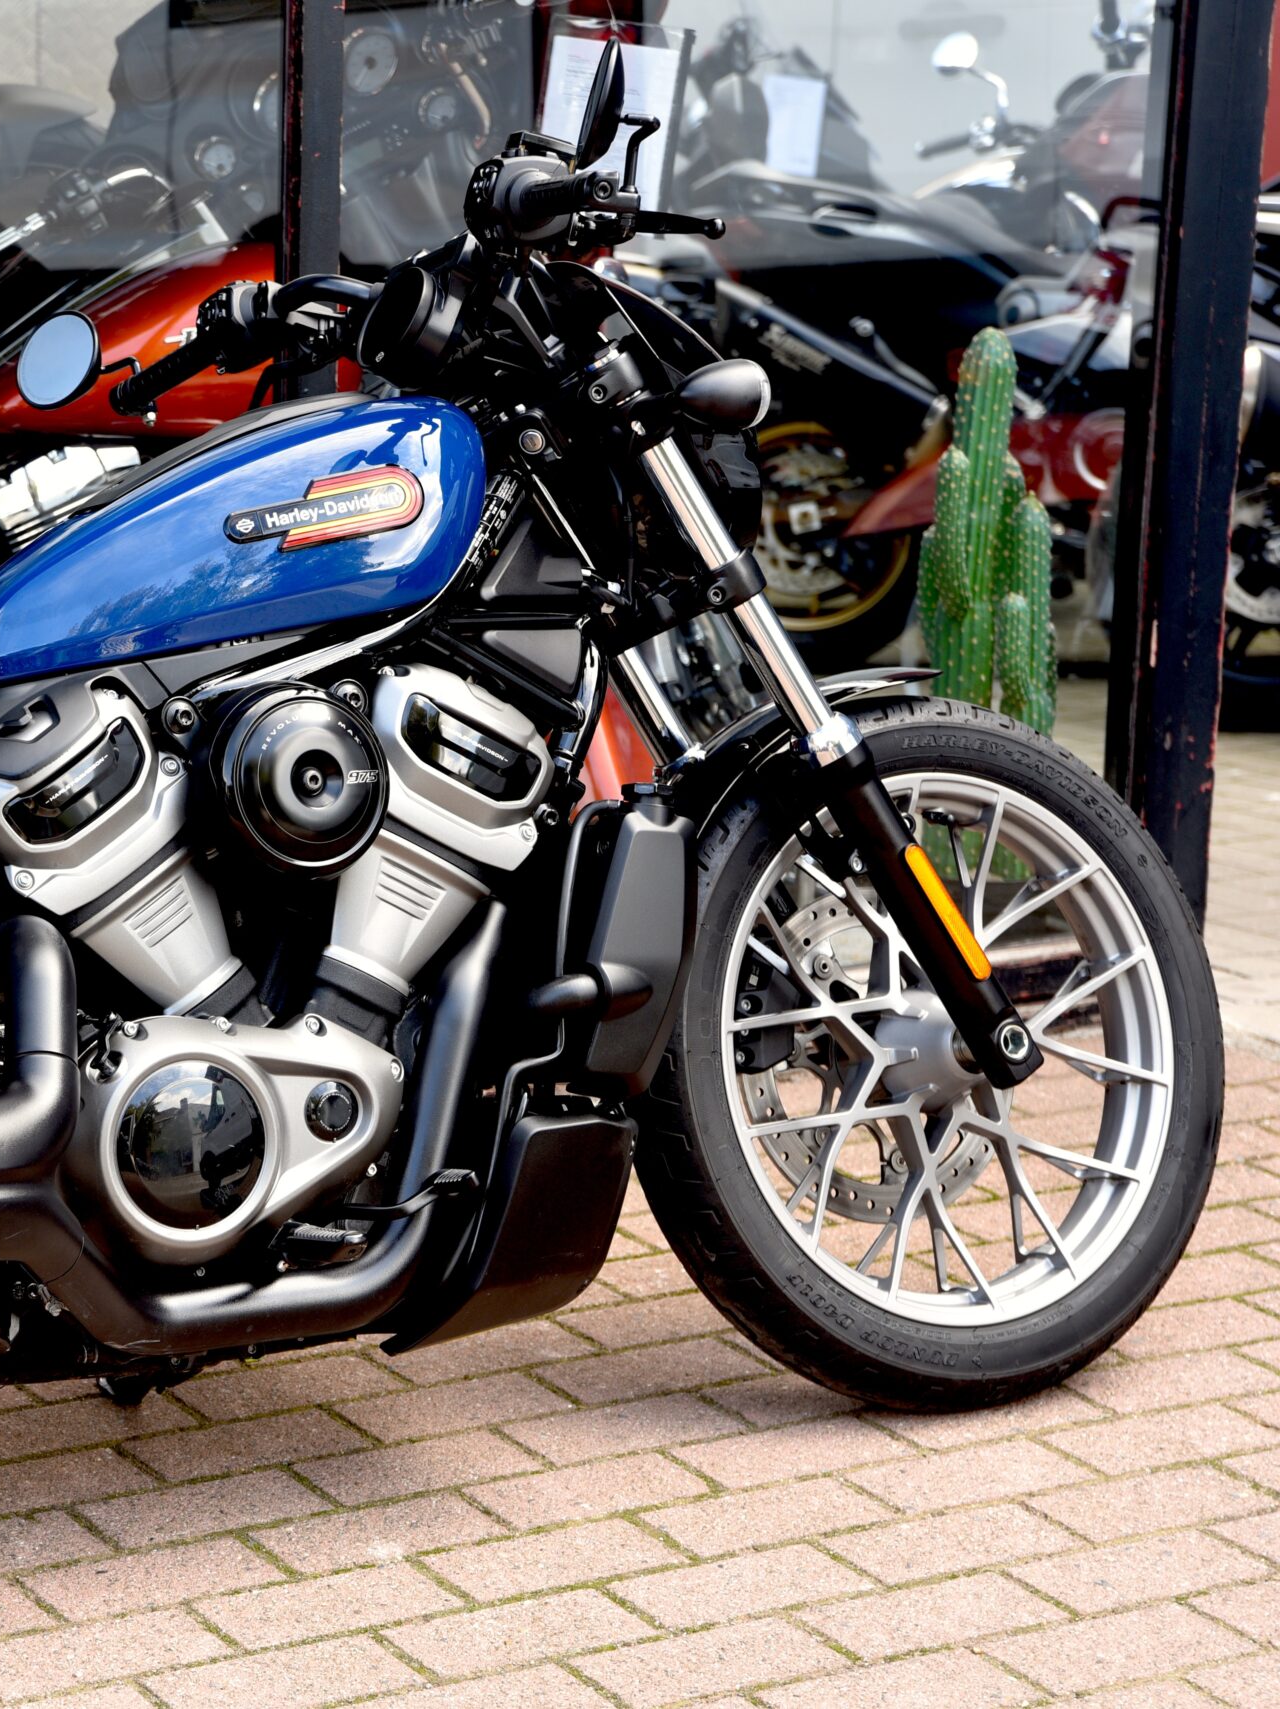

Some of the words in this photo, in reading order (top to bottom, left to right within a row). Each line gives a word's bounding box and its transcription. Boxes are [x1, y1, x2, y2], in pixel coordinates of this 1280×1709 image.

[337, 721, 362, 745] MAX
[347, 769, 378, 784] 975
[902, 733, 1128, 839] HARLEY-DAVIDSON
